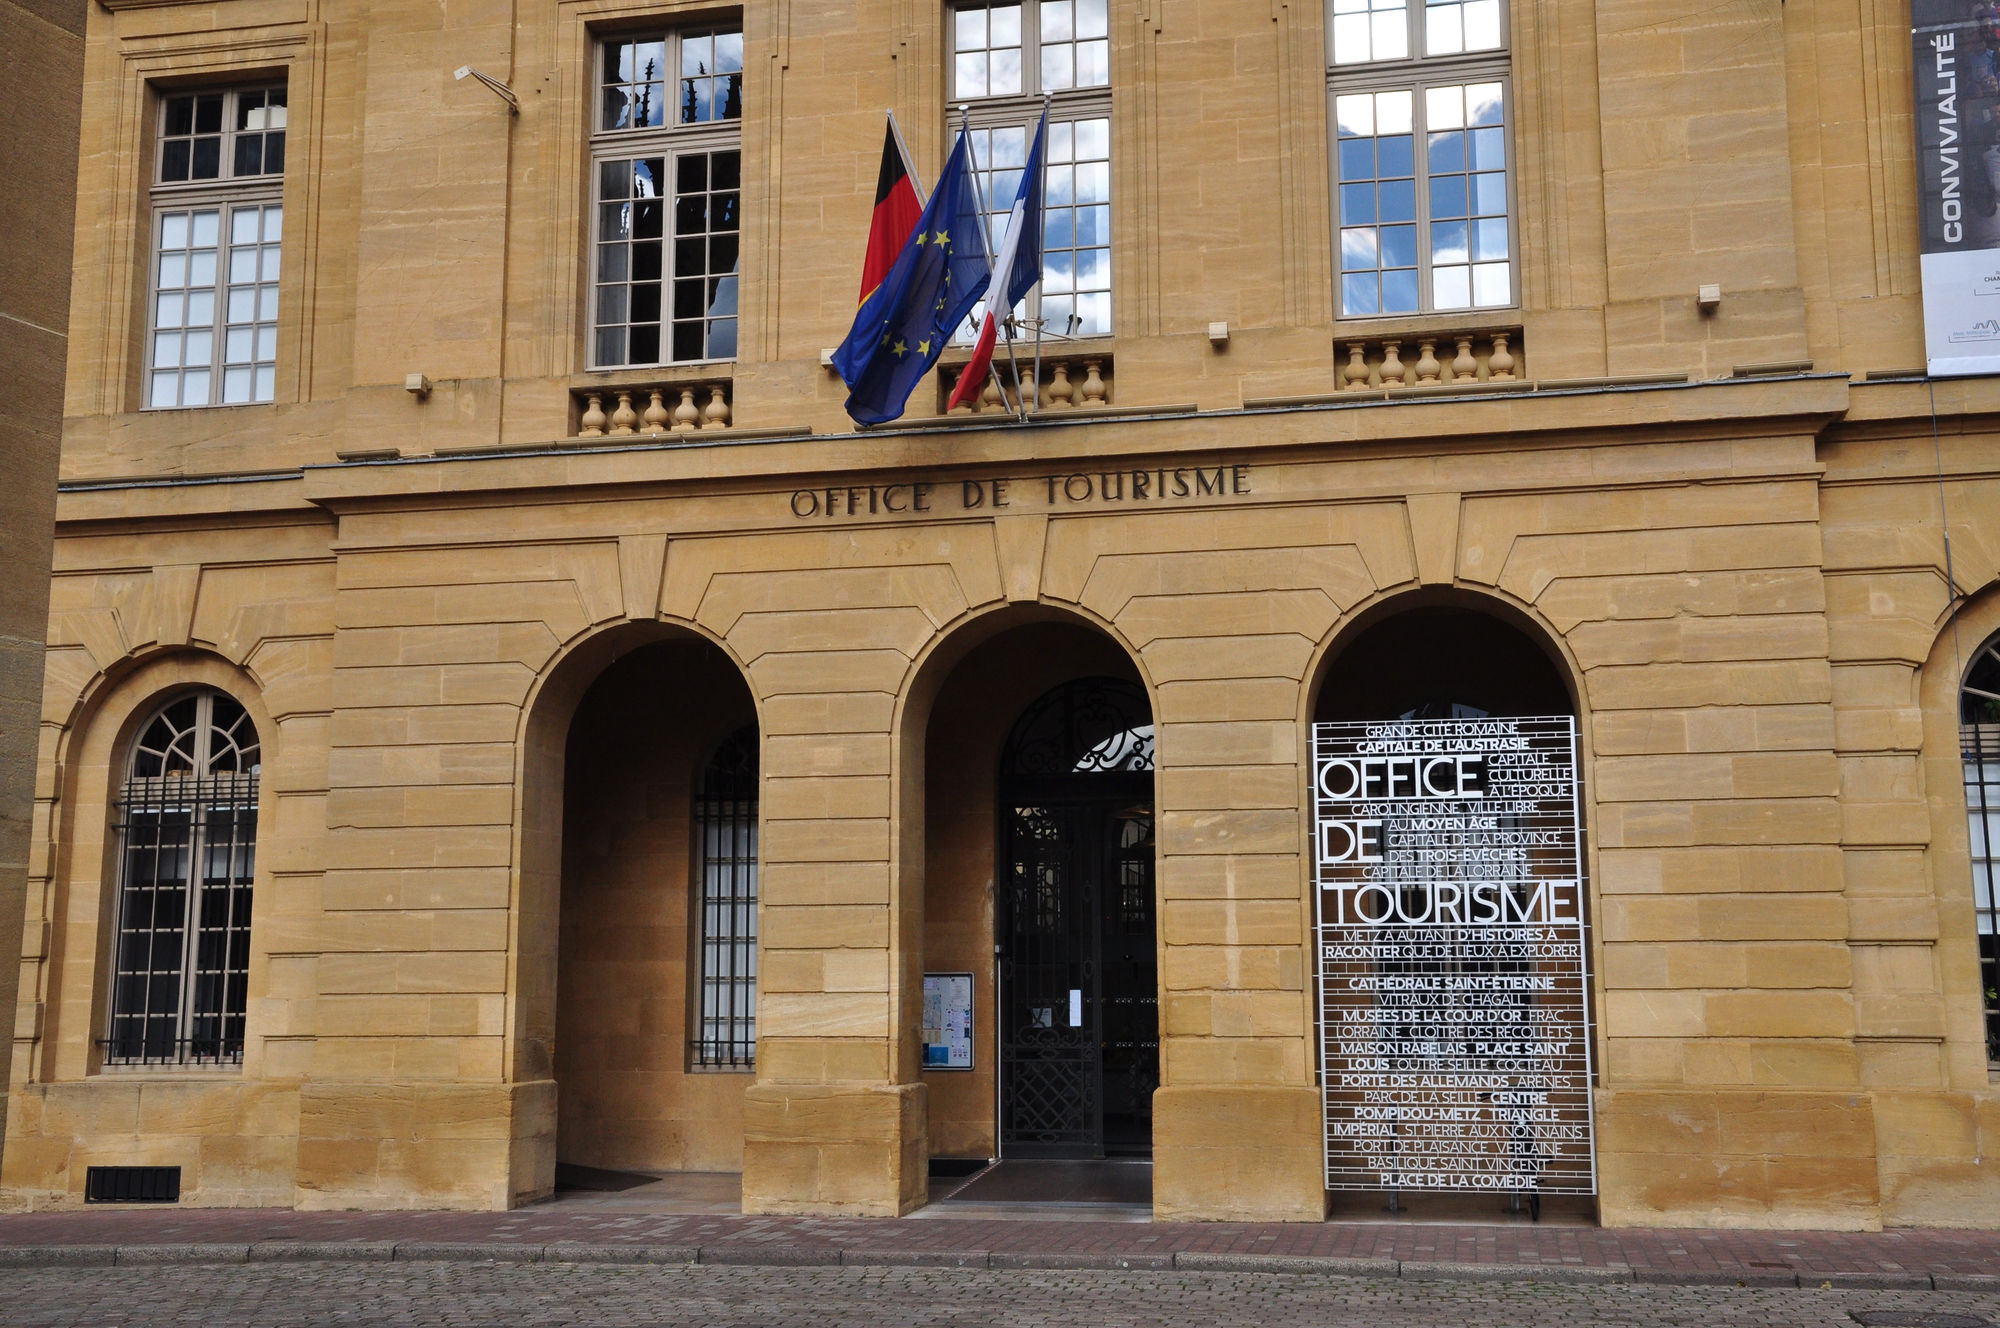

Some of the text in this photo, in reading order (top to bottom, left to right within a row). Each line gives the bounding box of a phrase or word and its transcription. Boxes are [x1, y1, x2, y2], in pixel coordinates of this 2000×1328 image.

[1930, 32, 1962, 243] CONVIVIALITÉ
[791, 464, 1251, 517] OFFICE DE TOURISME
[1366, 722, 1519, 738] GRANDE CITÉ ROMAINE
[1357, 741, 1421, 752] CAPITALE
[1425, 740, 1442, 752] DE
[1488, 754, 1550, 766] CAPITALE
[1319, 757, 1483, 798] OFFICE
[1488, 769, 1571, 782] CULTURELLE
[1490, 783, 1502, 796] À
[1352, 801, 1539, 815] CAROLINGIENNE VILLE LIBRE
[1388, 816, 1497, 830] AU MOYEN ÂGE
[1320, 821, 1382, 862] DE
[1389, 832, 1561, 847] CAPITALE DE LA PROVINCE
[1390, 847, 1527, 862] DES TROIS-ÉVÊCHÉS
[1362, 864, 1532, 879] CAPITALE DE LA LORRAINE
[1323, 883, 1576, 923] TOURISME
[1344, 931, 1381, 942] METZ
[1384, 931, 1394, 942] A
[1397, 930, 1454, 942] AUTANT
[1547, 927, 1557, 940] À
[1326, 943, 1577, 957] RACONTER QUE DE LIEUX À EXPLORER
[1349, 976, 1555, 990] CATHÉDRALE SAINT-ÉTIENNE
[1379, 994, 1525, 1006] VITRAUX DE CHAGALL
[1343, 1009, 1398, 1022] MUSÉES
[1402, 1011, 1420, 1022] DE
[1423, 1011, 1441, 1021] LA
[1444, 1011, 1484, 1021] COUR
[1529, 1010, 1564, 1021] FRAC
[1336, 1025, 1572, 1038] LORRAINE CLOÎTRE DES RÉCOLLETS
[1341, 1042, 1569, 1055] MAISON RABELAIS PLACE SAINT
[1348, 1059, 1562, 1071] LOUIS OUTRE SEILLE COCTEAU
[1342, 1074, 1571, 1087] PORTE DES ALLEMANDS ARÈNES
[1365, 1092, 1548, 1104] PARC DE LA SEILLE CENTRE
[1355, 1108, 1559, 1121] POMPIDOU-METZ TRIANGLE
[1334, 1122, 1583, 1137] IMPÉRIAL ST PIERRE AUX NONNAINS
[1354, 1141, 1563, 1154] PORT DE PLAISANCE VERLAINE
[1369, 1157, 1549, 1171] BASILIQUE SAINT VINCENT
[1381, 1174, 1537, 1188] PLACE DE LA COMÉDIE
